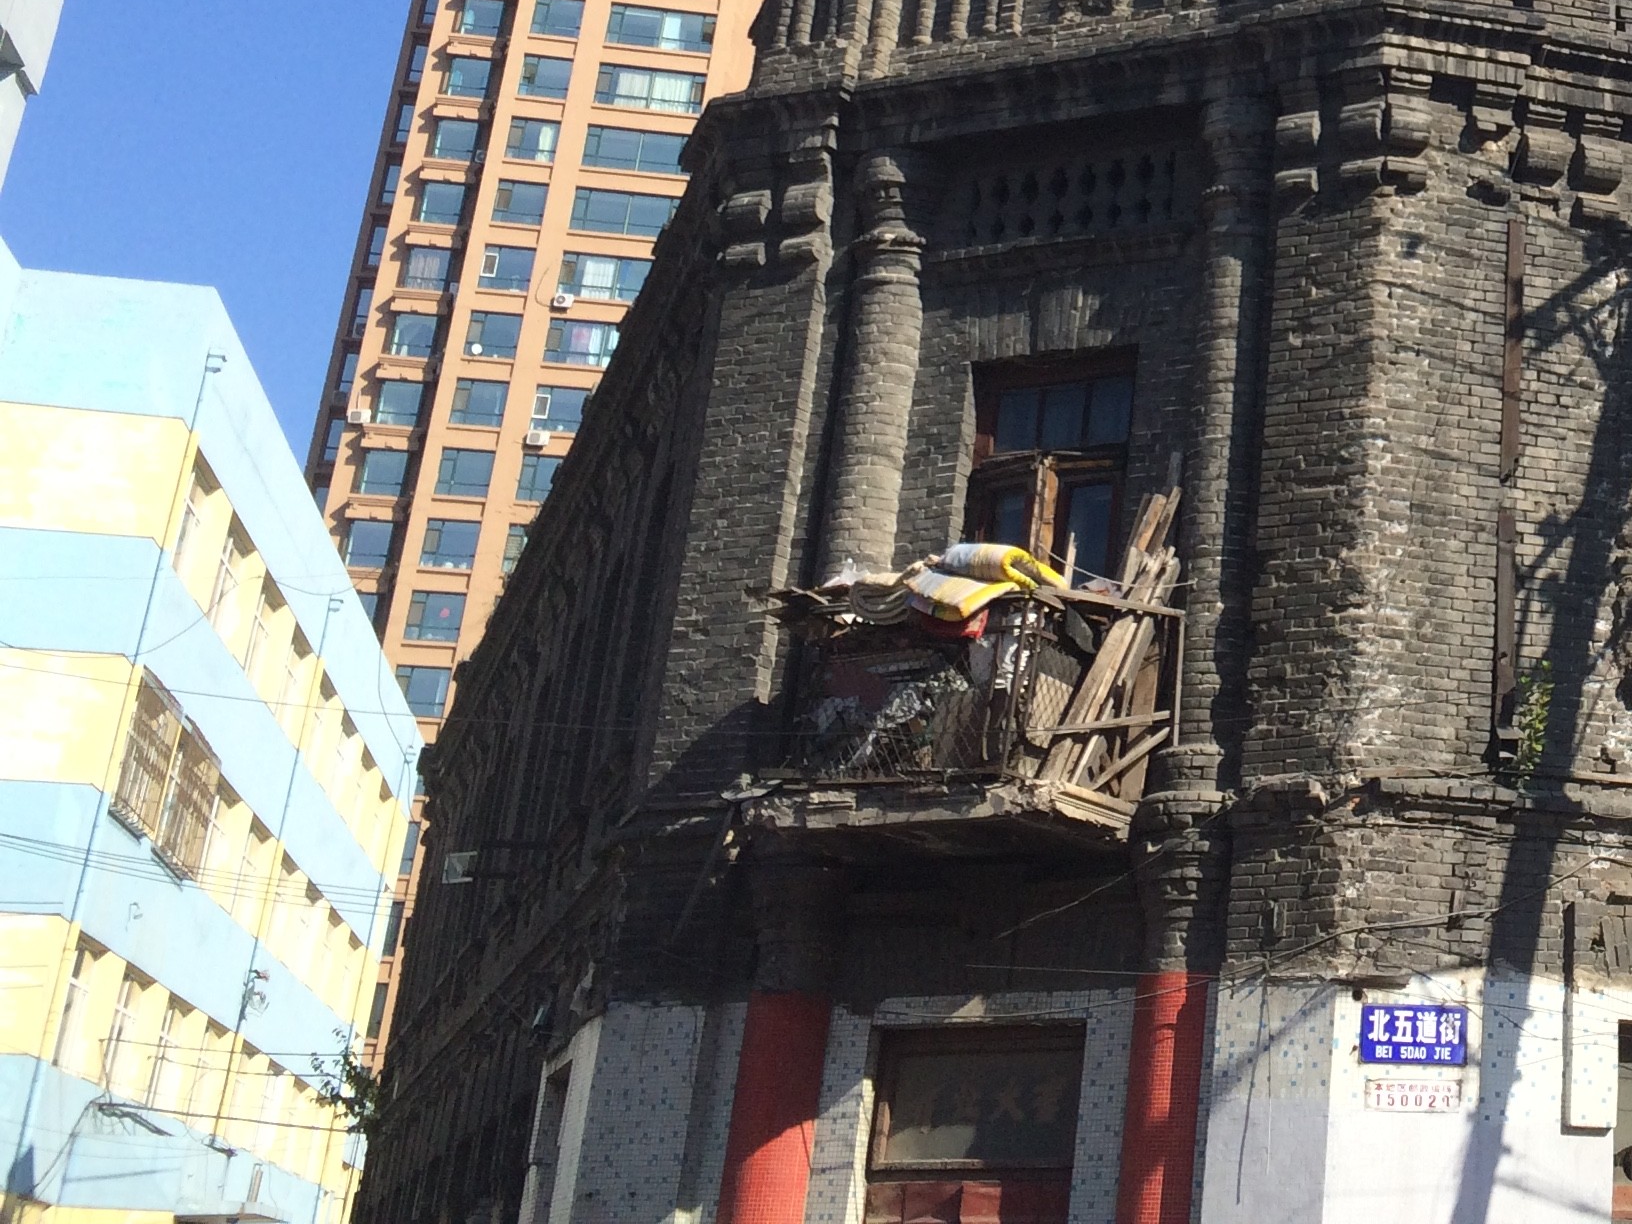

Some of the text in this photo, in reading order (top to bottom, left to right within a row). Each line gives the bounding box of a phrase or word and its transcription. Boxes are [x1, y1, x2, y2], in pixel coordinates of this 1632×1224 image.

[1367, 1009, 1461, 1044] 北五道街
[1375, 1044, 1393, 1059] BEI
[1433, 1046, 1452, 1060] JIE
